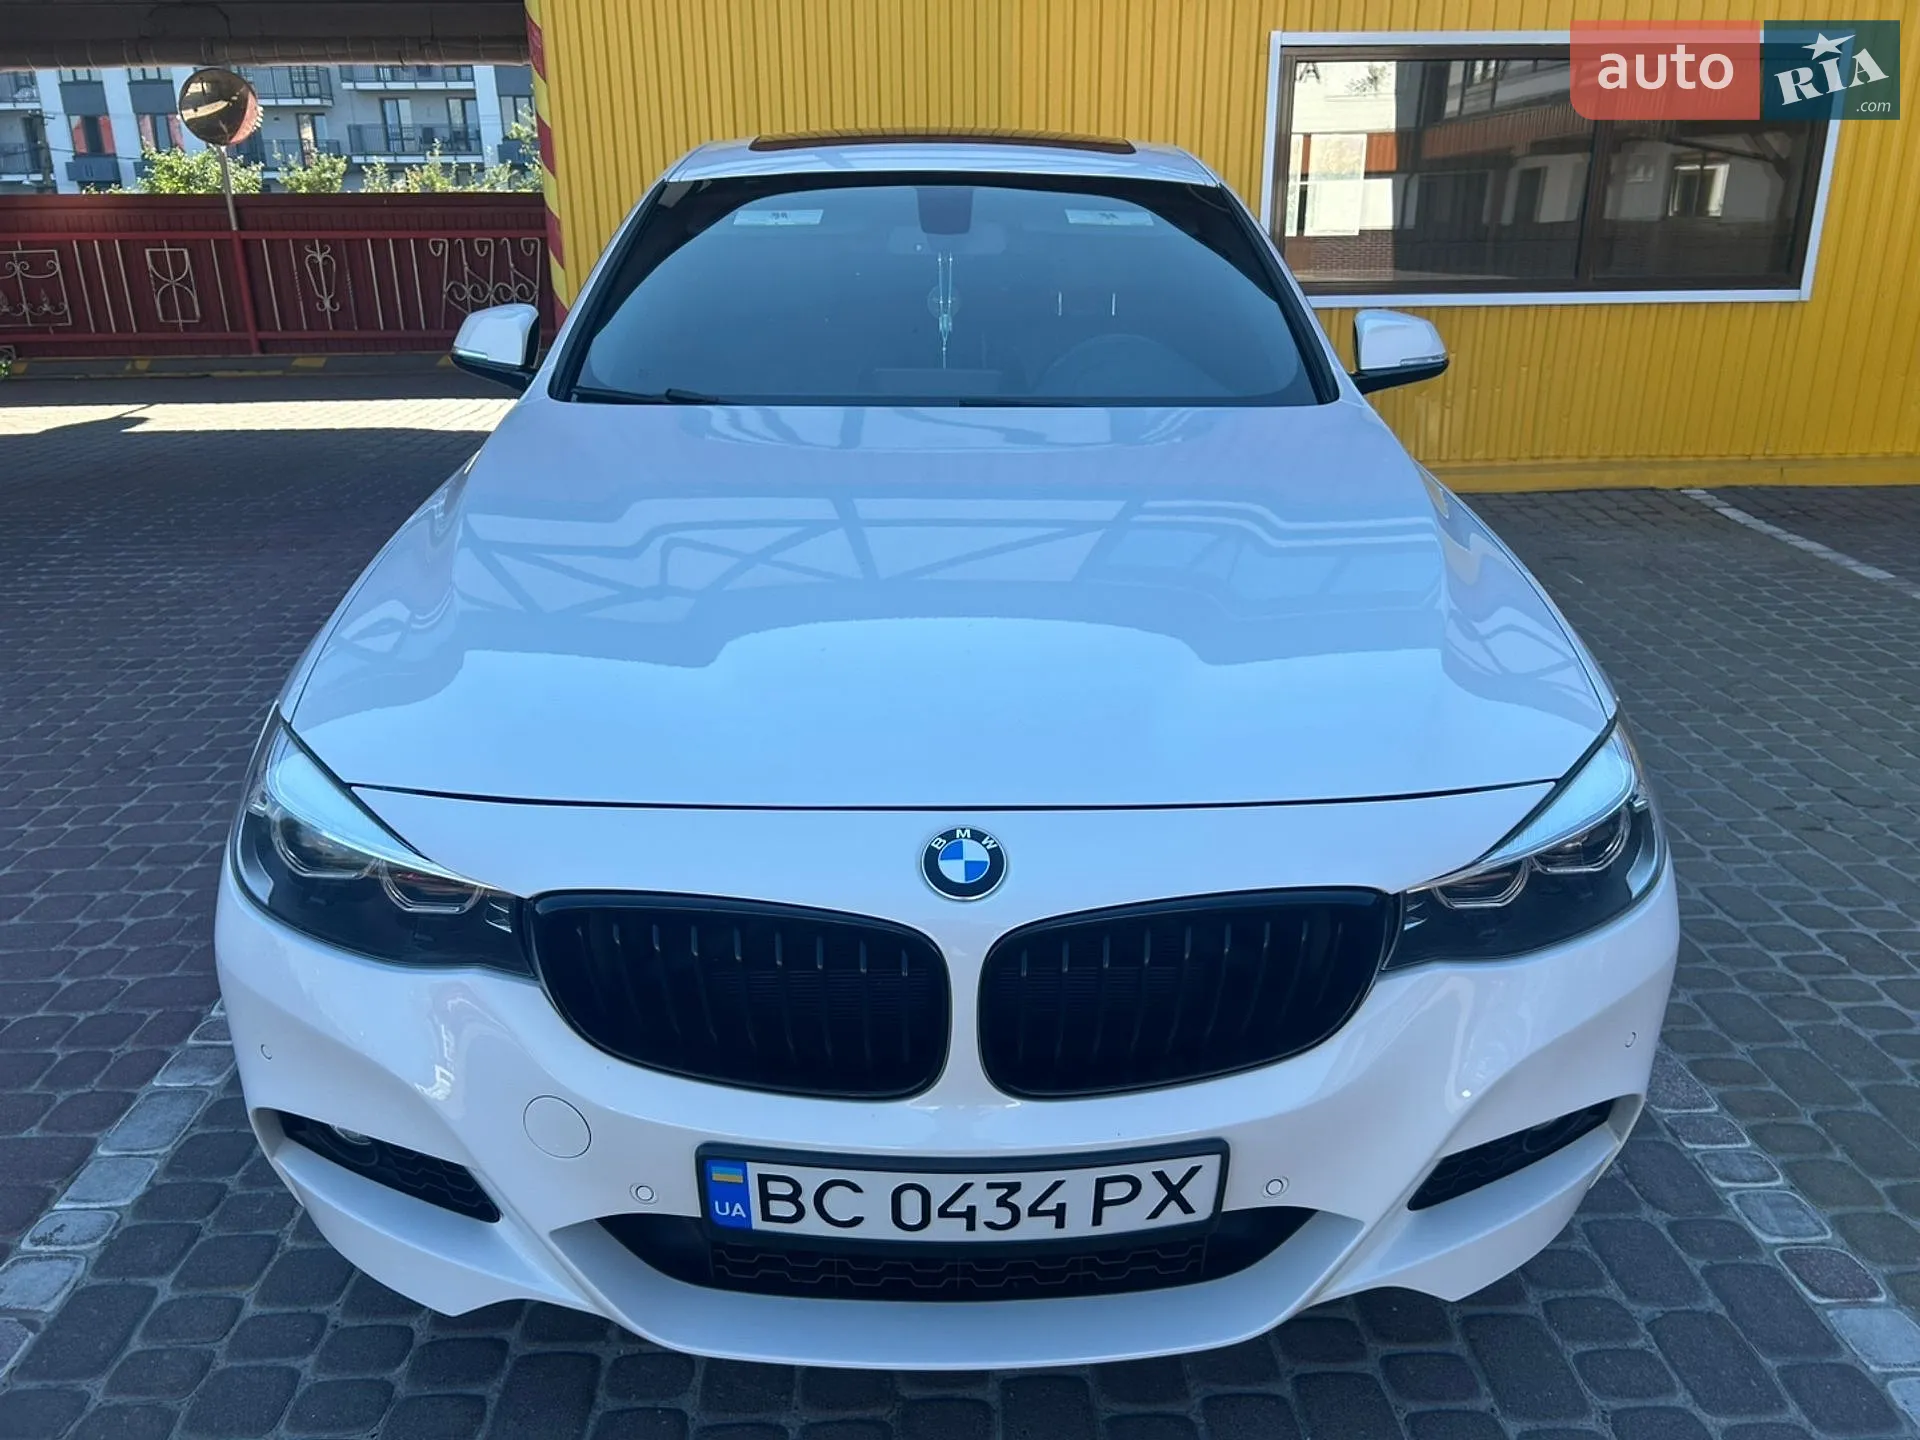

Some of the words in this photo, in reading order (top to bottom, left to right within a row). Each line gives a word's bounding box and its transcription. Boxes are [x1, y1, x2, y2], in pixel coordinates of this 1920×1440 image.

[930, 828, 998, 851] BMW
[714, 1200, 747, 1218] UA
[757, 1173, 865, 1229] BC
[891, 1180, 1066, 1232] 0434
[1091, 1165, 1203, 1227] PX
